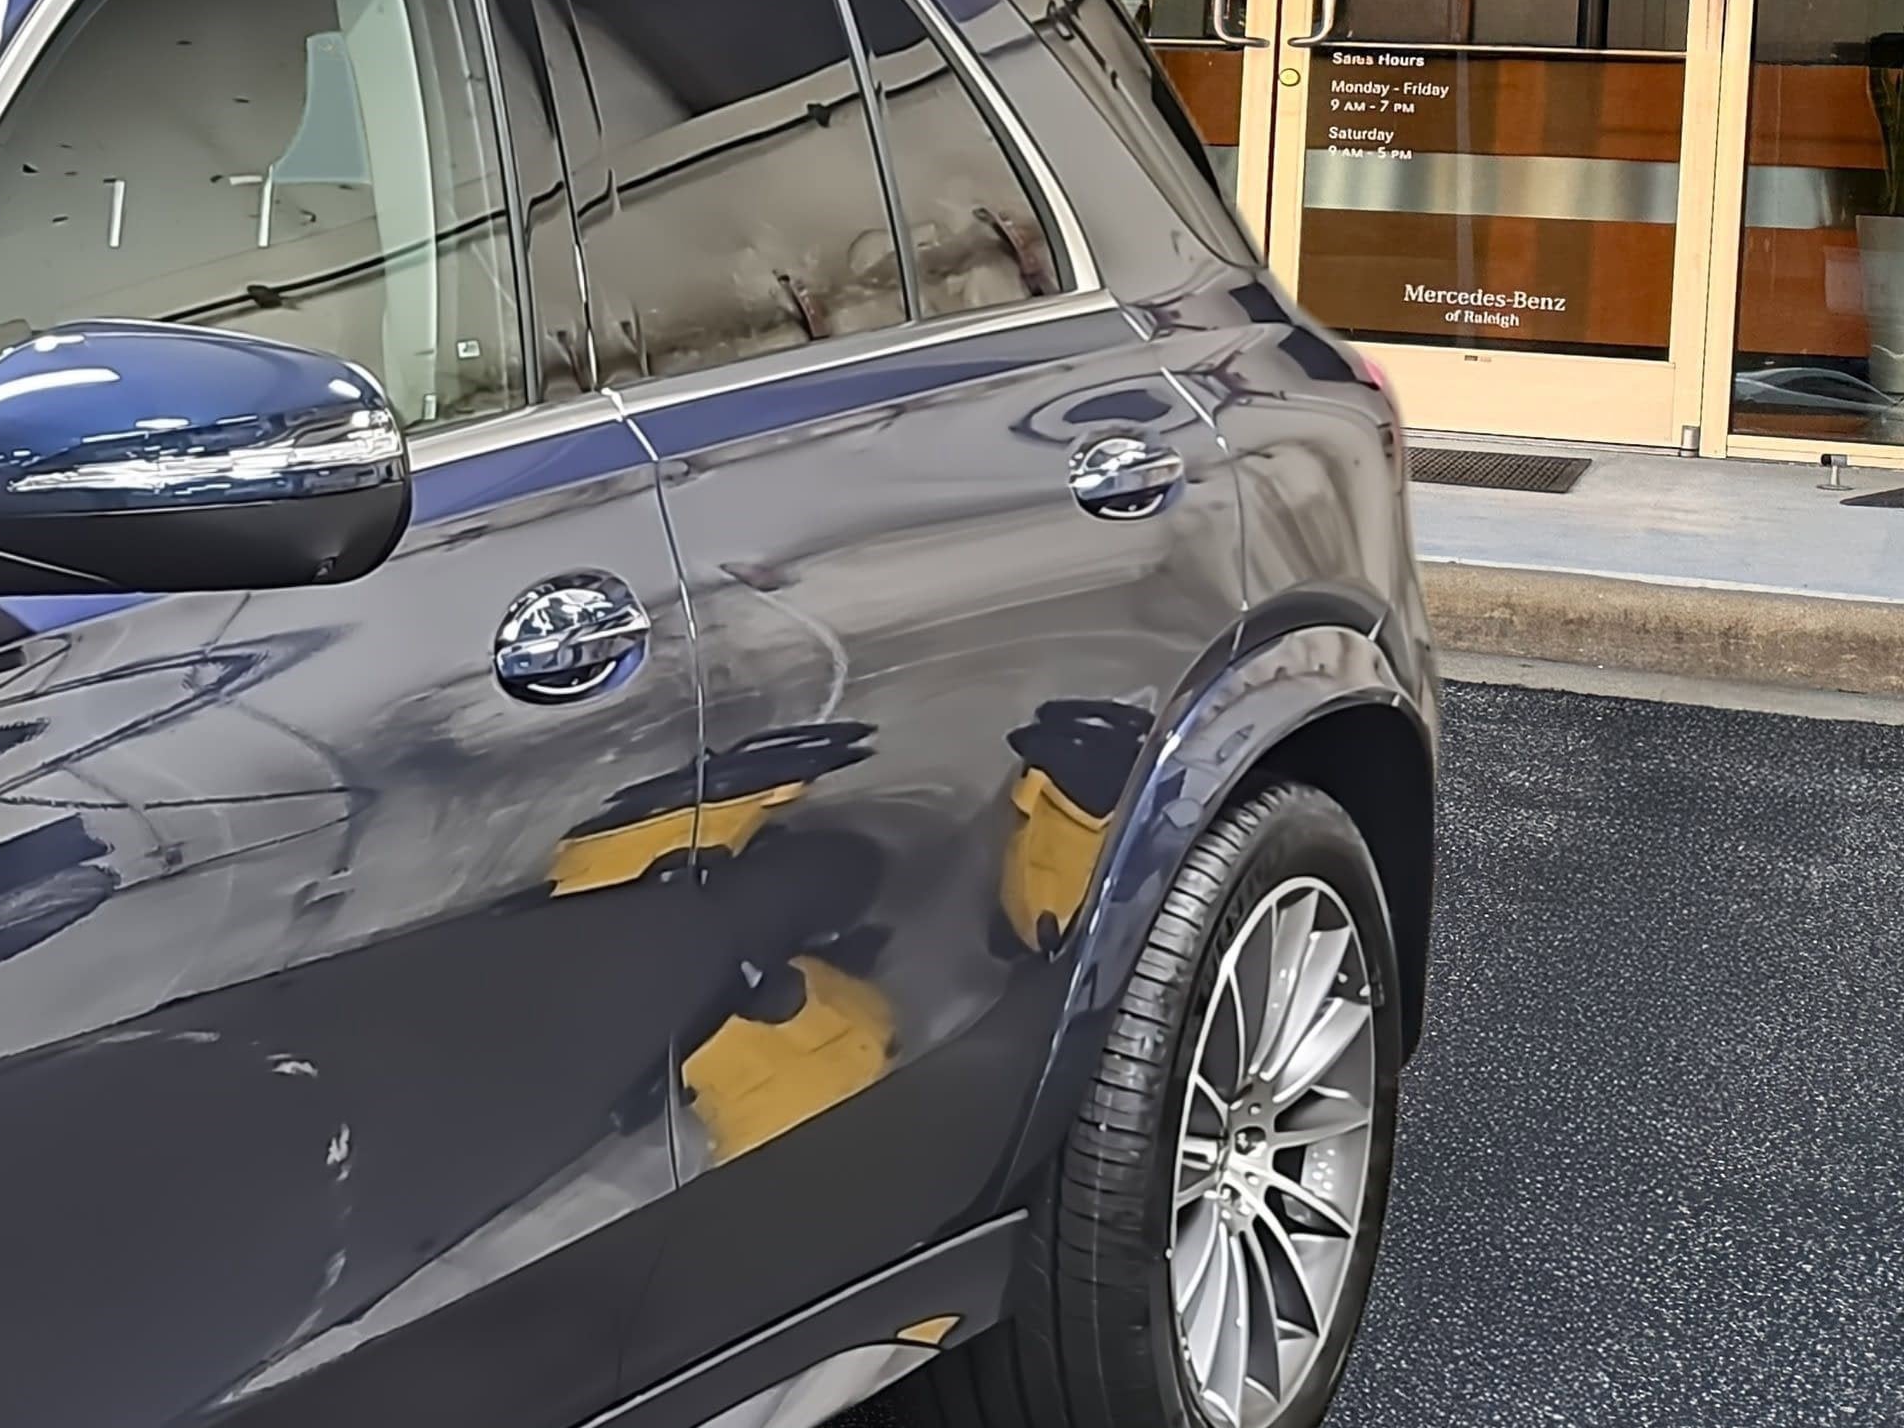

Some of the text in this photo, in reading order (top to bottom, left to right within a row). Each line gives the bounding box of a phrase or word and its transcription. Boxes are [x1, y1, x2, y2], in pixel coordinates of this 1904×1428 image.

[1378, 53, 1425, 67] Hours
[1331, 79, 1390, 97] Monday
[1403, 81, 1449, 98] Friday
[1330, 98, 1341, 111] 9
[1343, 101, 1366, 111] AM
[1379, 99, 1389, 112] 7
[1393, 103, 1415, 113] PM
[1328, 126, 1394, 144] Saturday
[1328, 144, 1338, 157] 9
[1341, 147, 1363, 158] AM
[1377, 146, 1387, 159] 5
[1391, 149, 1412, 160] PM
[1403, 283, 1566, 312] Mercedes-Benz
[1444, 309, 1462, 322] of
